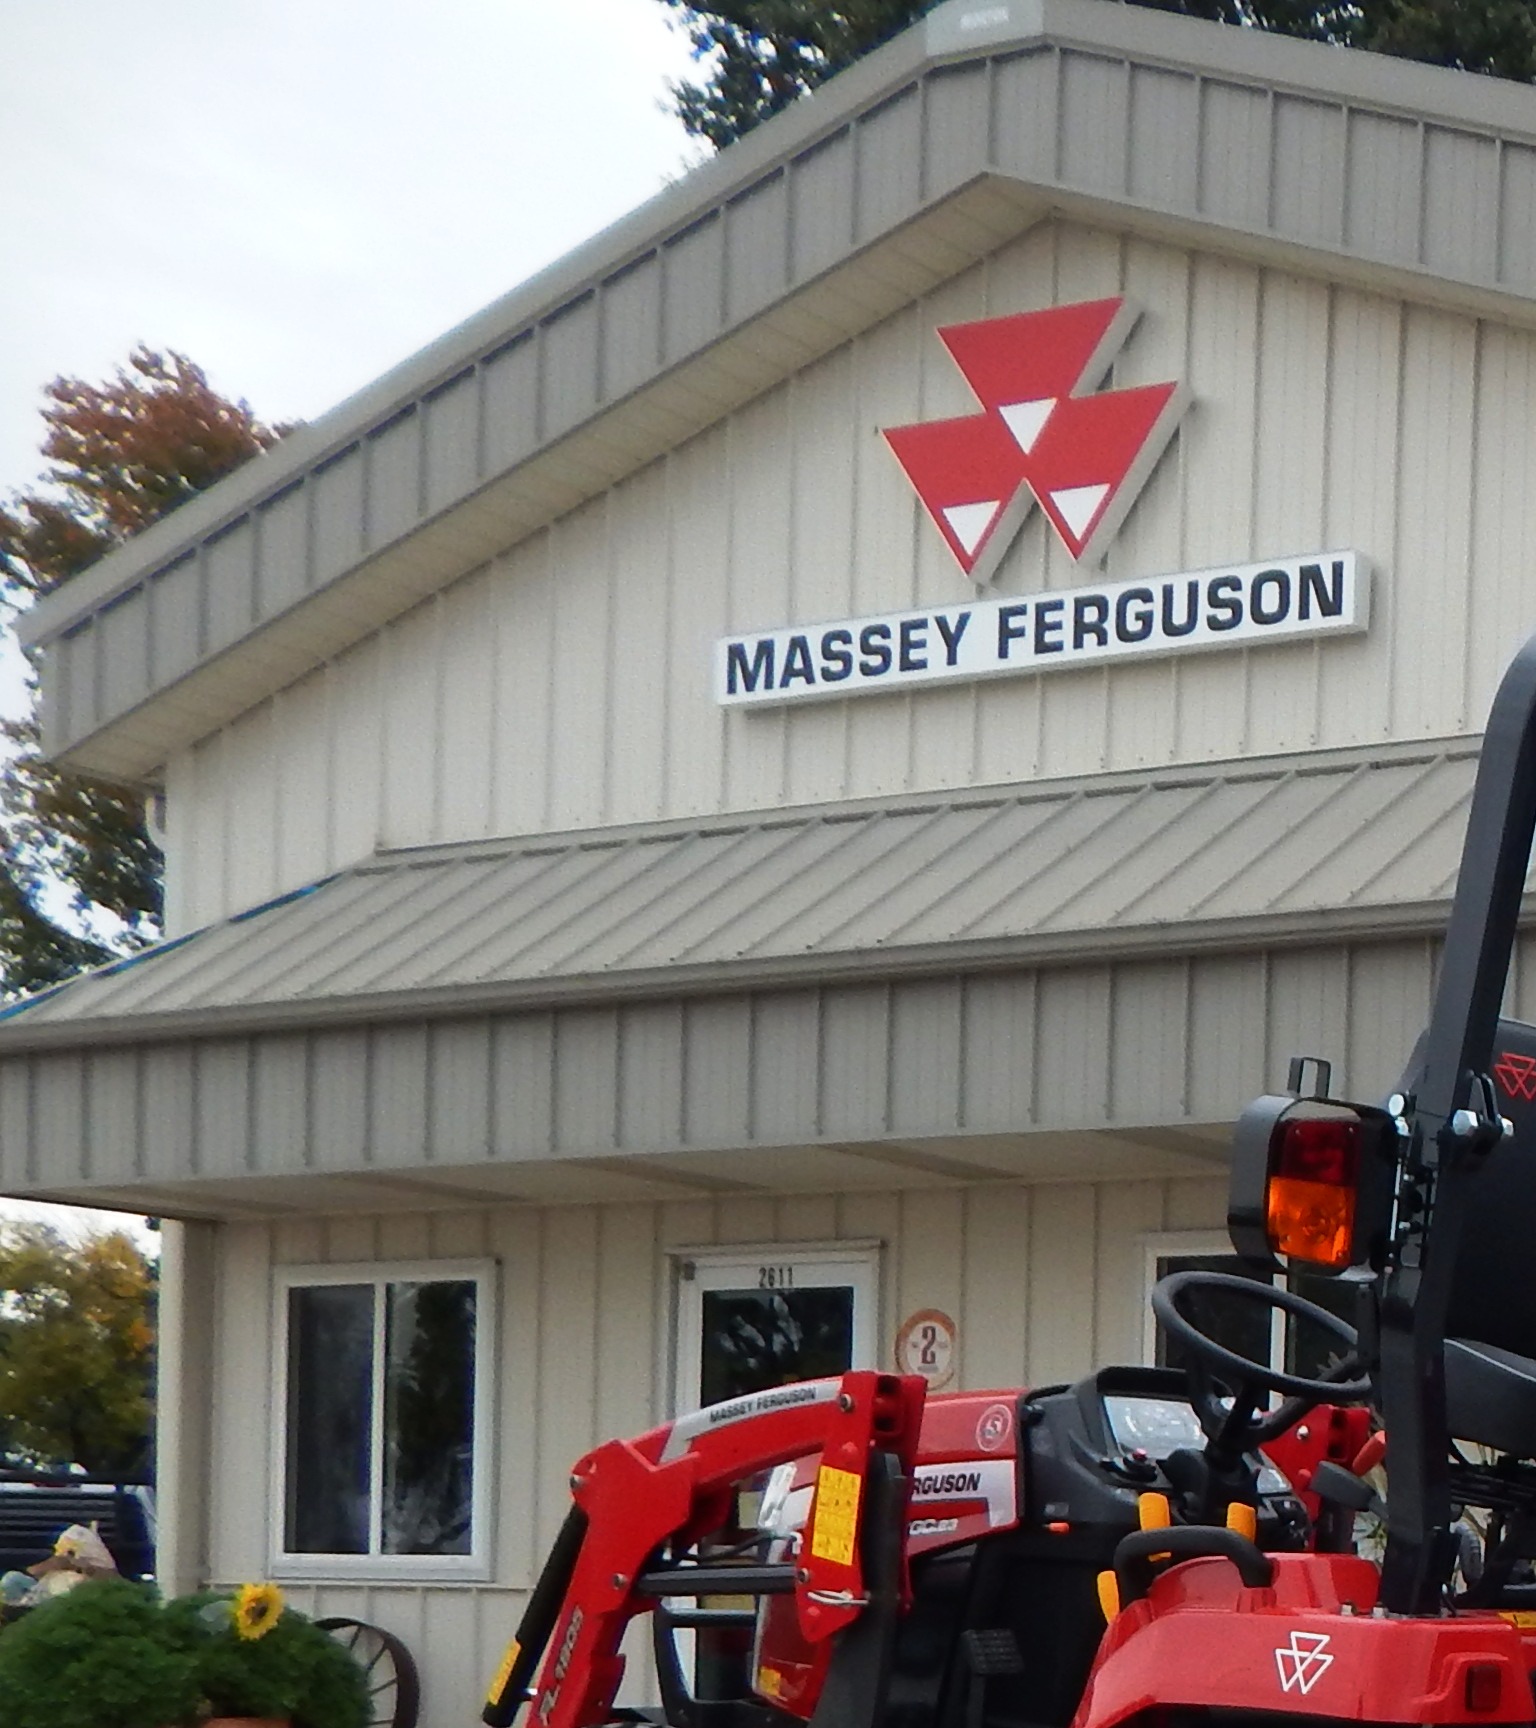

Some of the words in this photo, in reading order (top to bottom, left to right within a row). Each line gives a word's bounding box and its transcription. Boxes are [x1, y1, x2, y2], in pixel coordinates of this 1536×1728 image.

[726, 611, 970, 694] MASSEY
[998, 561, 1345, 659] FERGUSON
[759, 1266, 794, 1288] 2611
[921, 1325, 937, 1365] 2
[912, 1473, 980, 1495] RGUSON
